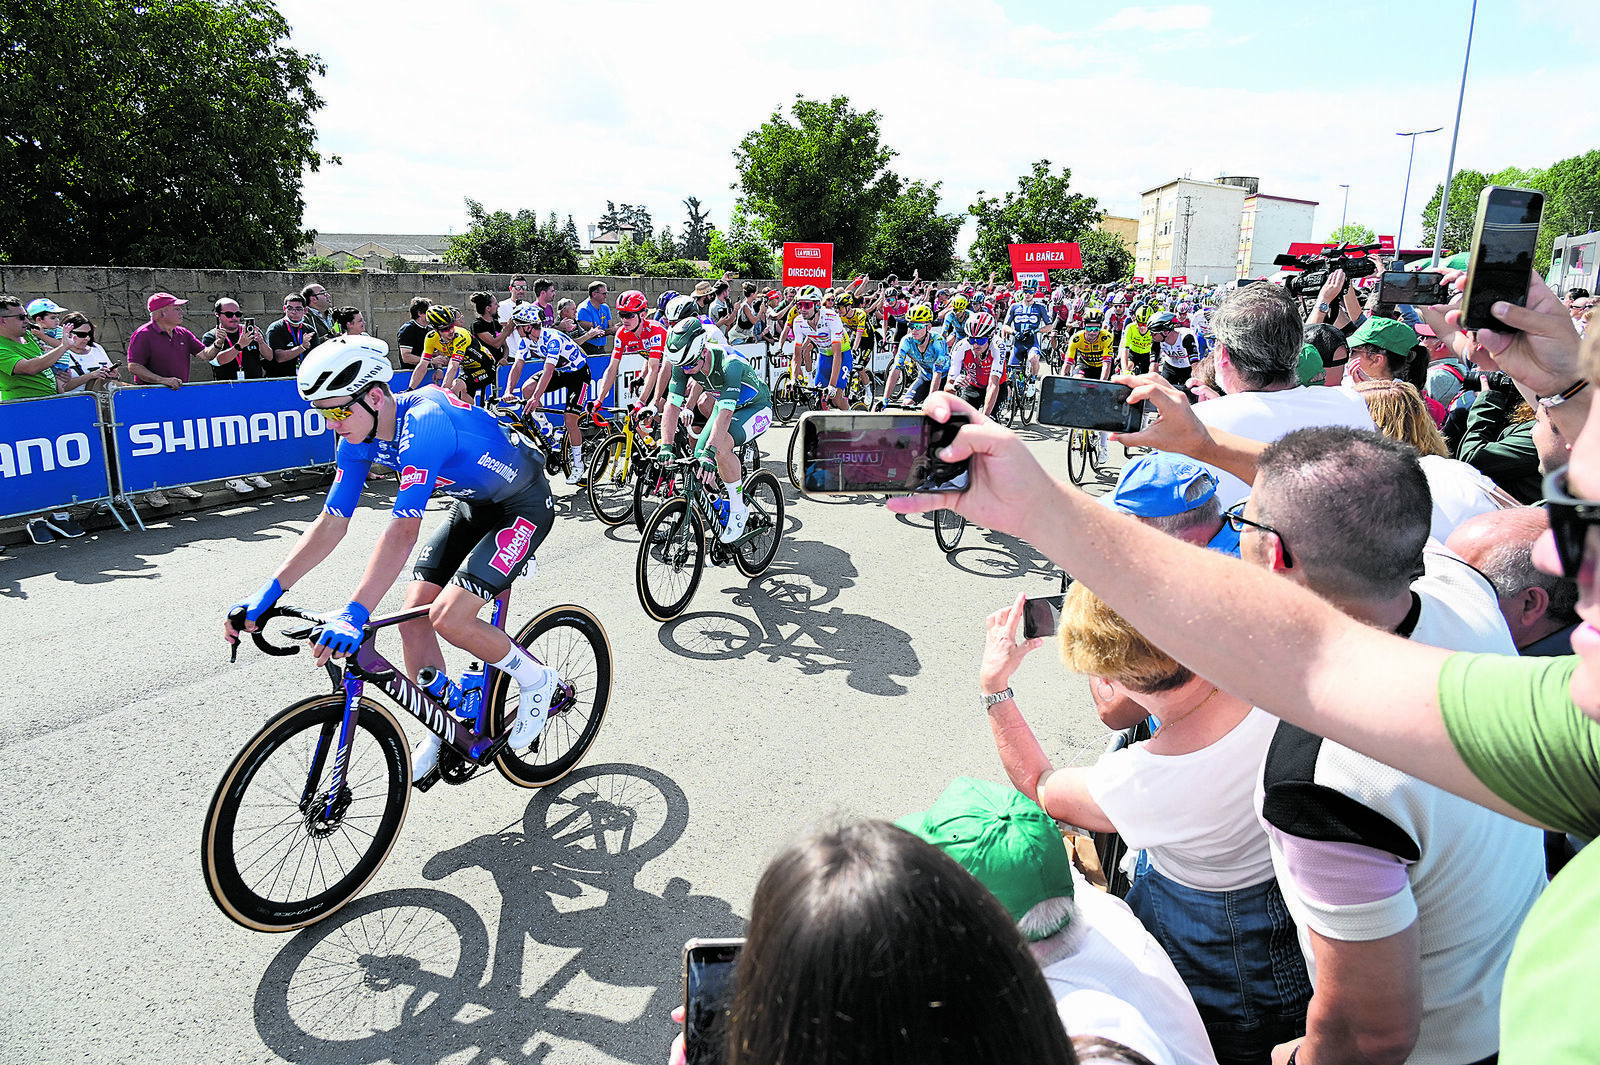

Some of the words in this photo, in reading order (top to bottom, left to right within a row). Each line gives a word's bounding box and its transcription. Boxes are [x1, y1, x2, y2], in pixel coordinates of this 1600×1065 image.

[788, 266, 827, 278] DIRECCIÓN
[1025, 252, 1035, 262] LA
[1036, 250, 1065, 261] BAÑEZA
[346, 364, 384, 393] CANYON
[128, 408, 327, 457] SHIMANO
[477, 451, 519, 484] deceuninck
[498, 524, 531, 569] Alpecin
[385, 676, 456, 745] CANYON
[326, 743, 349, 806] CANYON
